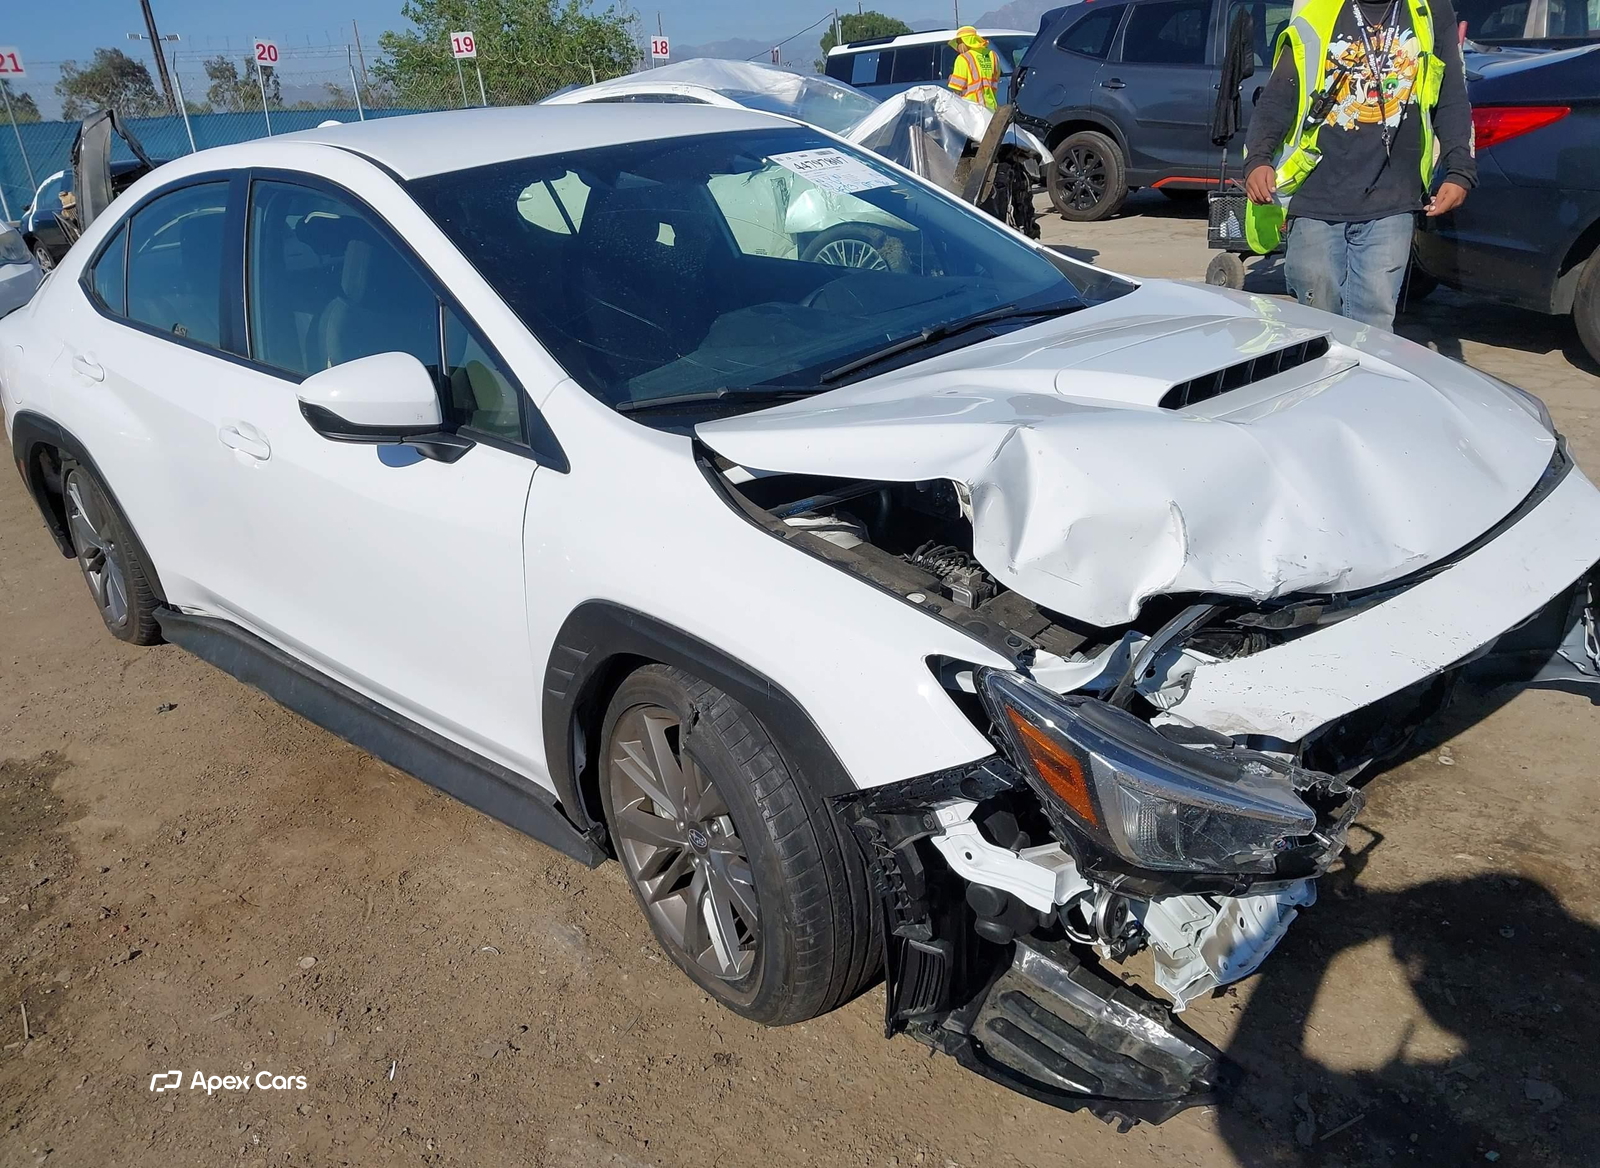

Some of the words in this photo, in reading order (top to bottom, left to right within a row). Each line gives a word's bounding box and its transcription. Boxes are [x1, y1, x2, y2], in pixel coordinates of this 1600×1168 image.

[256, 43, 278, 61] 20
[453, 37, 474, 53] 19
[653, 41, 668, 54] 18
